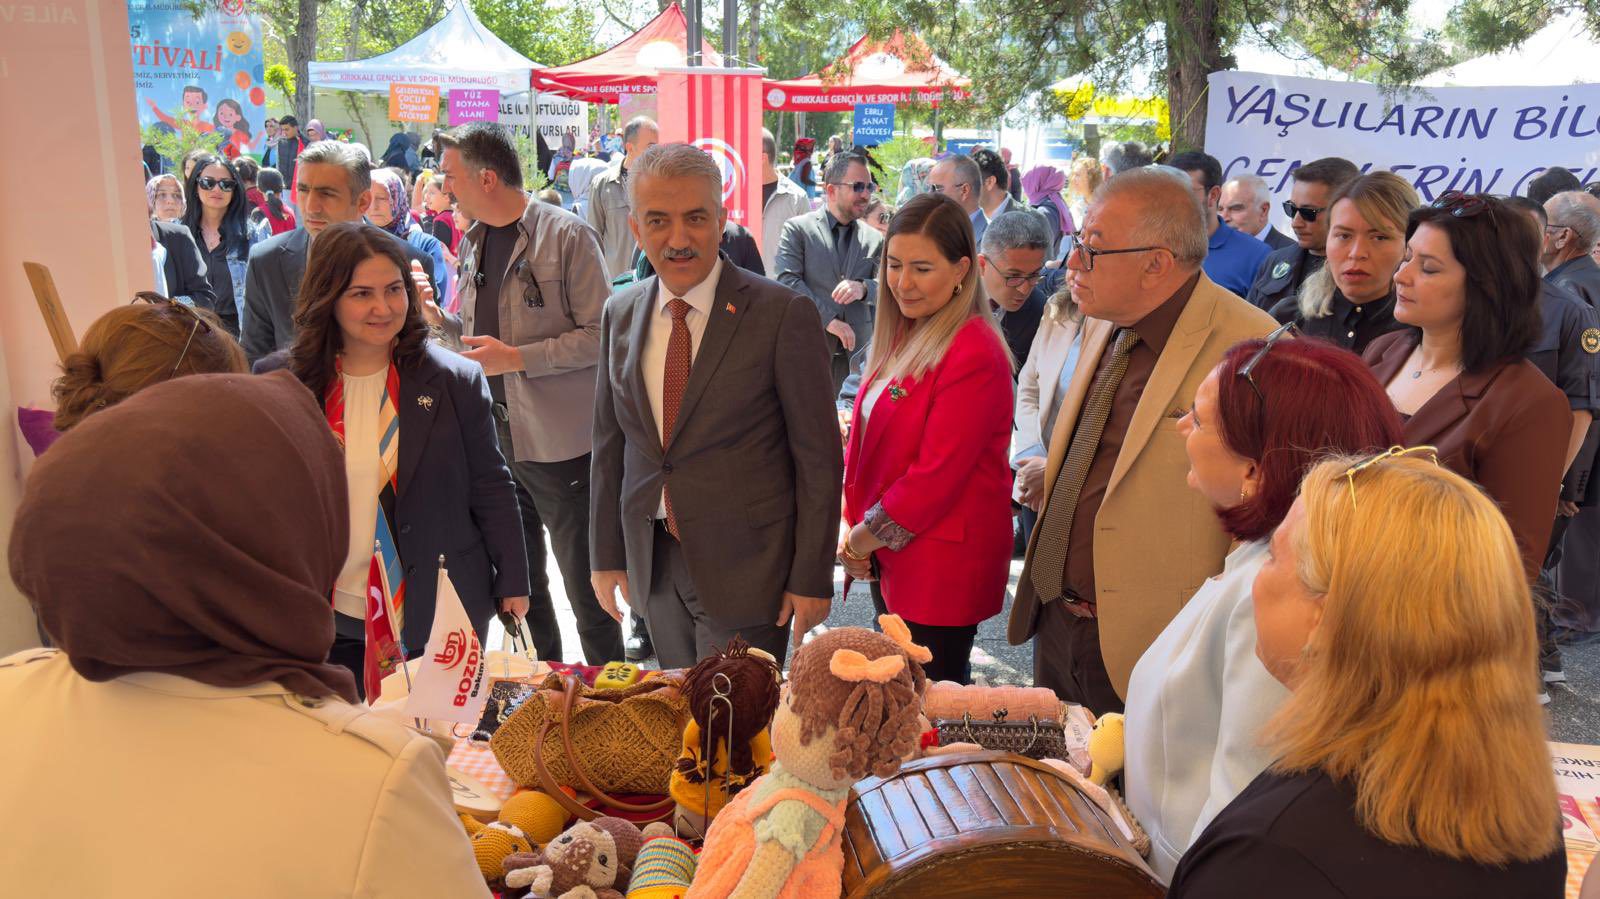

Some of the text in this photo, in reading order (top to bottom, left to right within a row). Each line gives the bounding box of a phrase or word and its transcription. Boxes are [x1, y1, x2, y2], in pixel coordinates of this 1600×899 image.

[407, 75, 417, 83] VE
[419, 75, 438, 84] SPOR
[599, 84, 629, 95] GENÇLİK
[631, 85, 641, 93] VE
[463, 91, 482, 99] YÜZ
[791, 94, 829, 104] KIRIKKALE
[830, 93, 864, 106] GENÇLİK
[865, 94, 877, 103] VE
[877, 93, 899, 103] SPOR
[456, 100, 490, 108] BOYAMA
[864, 107, 884, 116] EBRU
[1226, 85, 1600, 140] YAŞLILARIN BİL
[862, 117, 889, 126] SANAT
